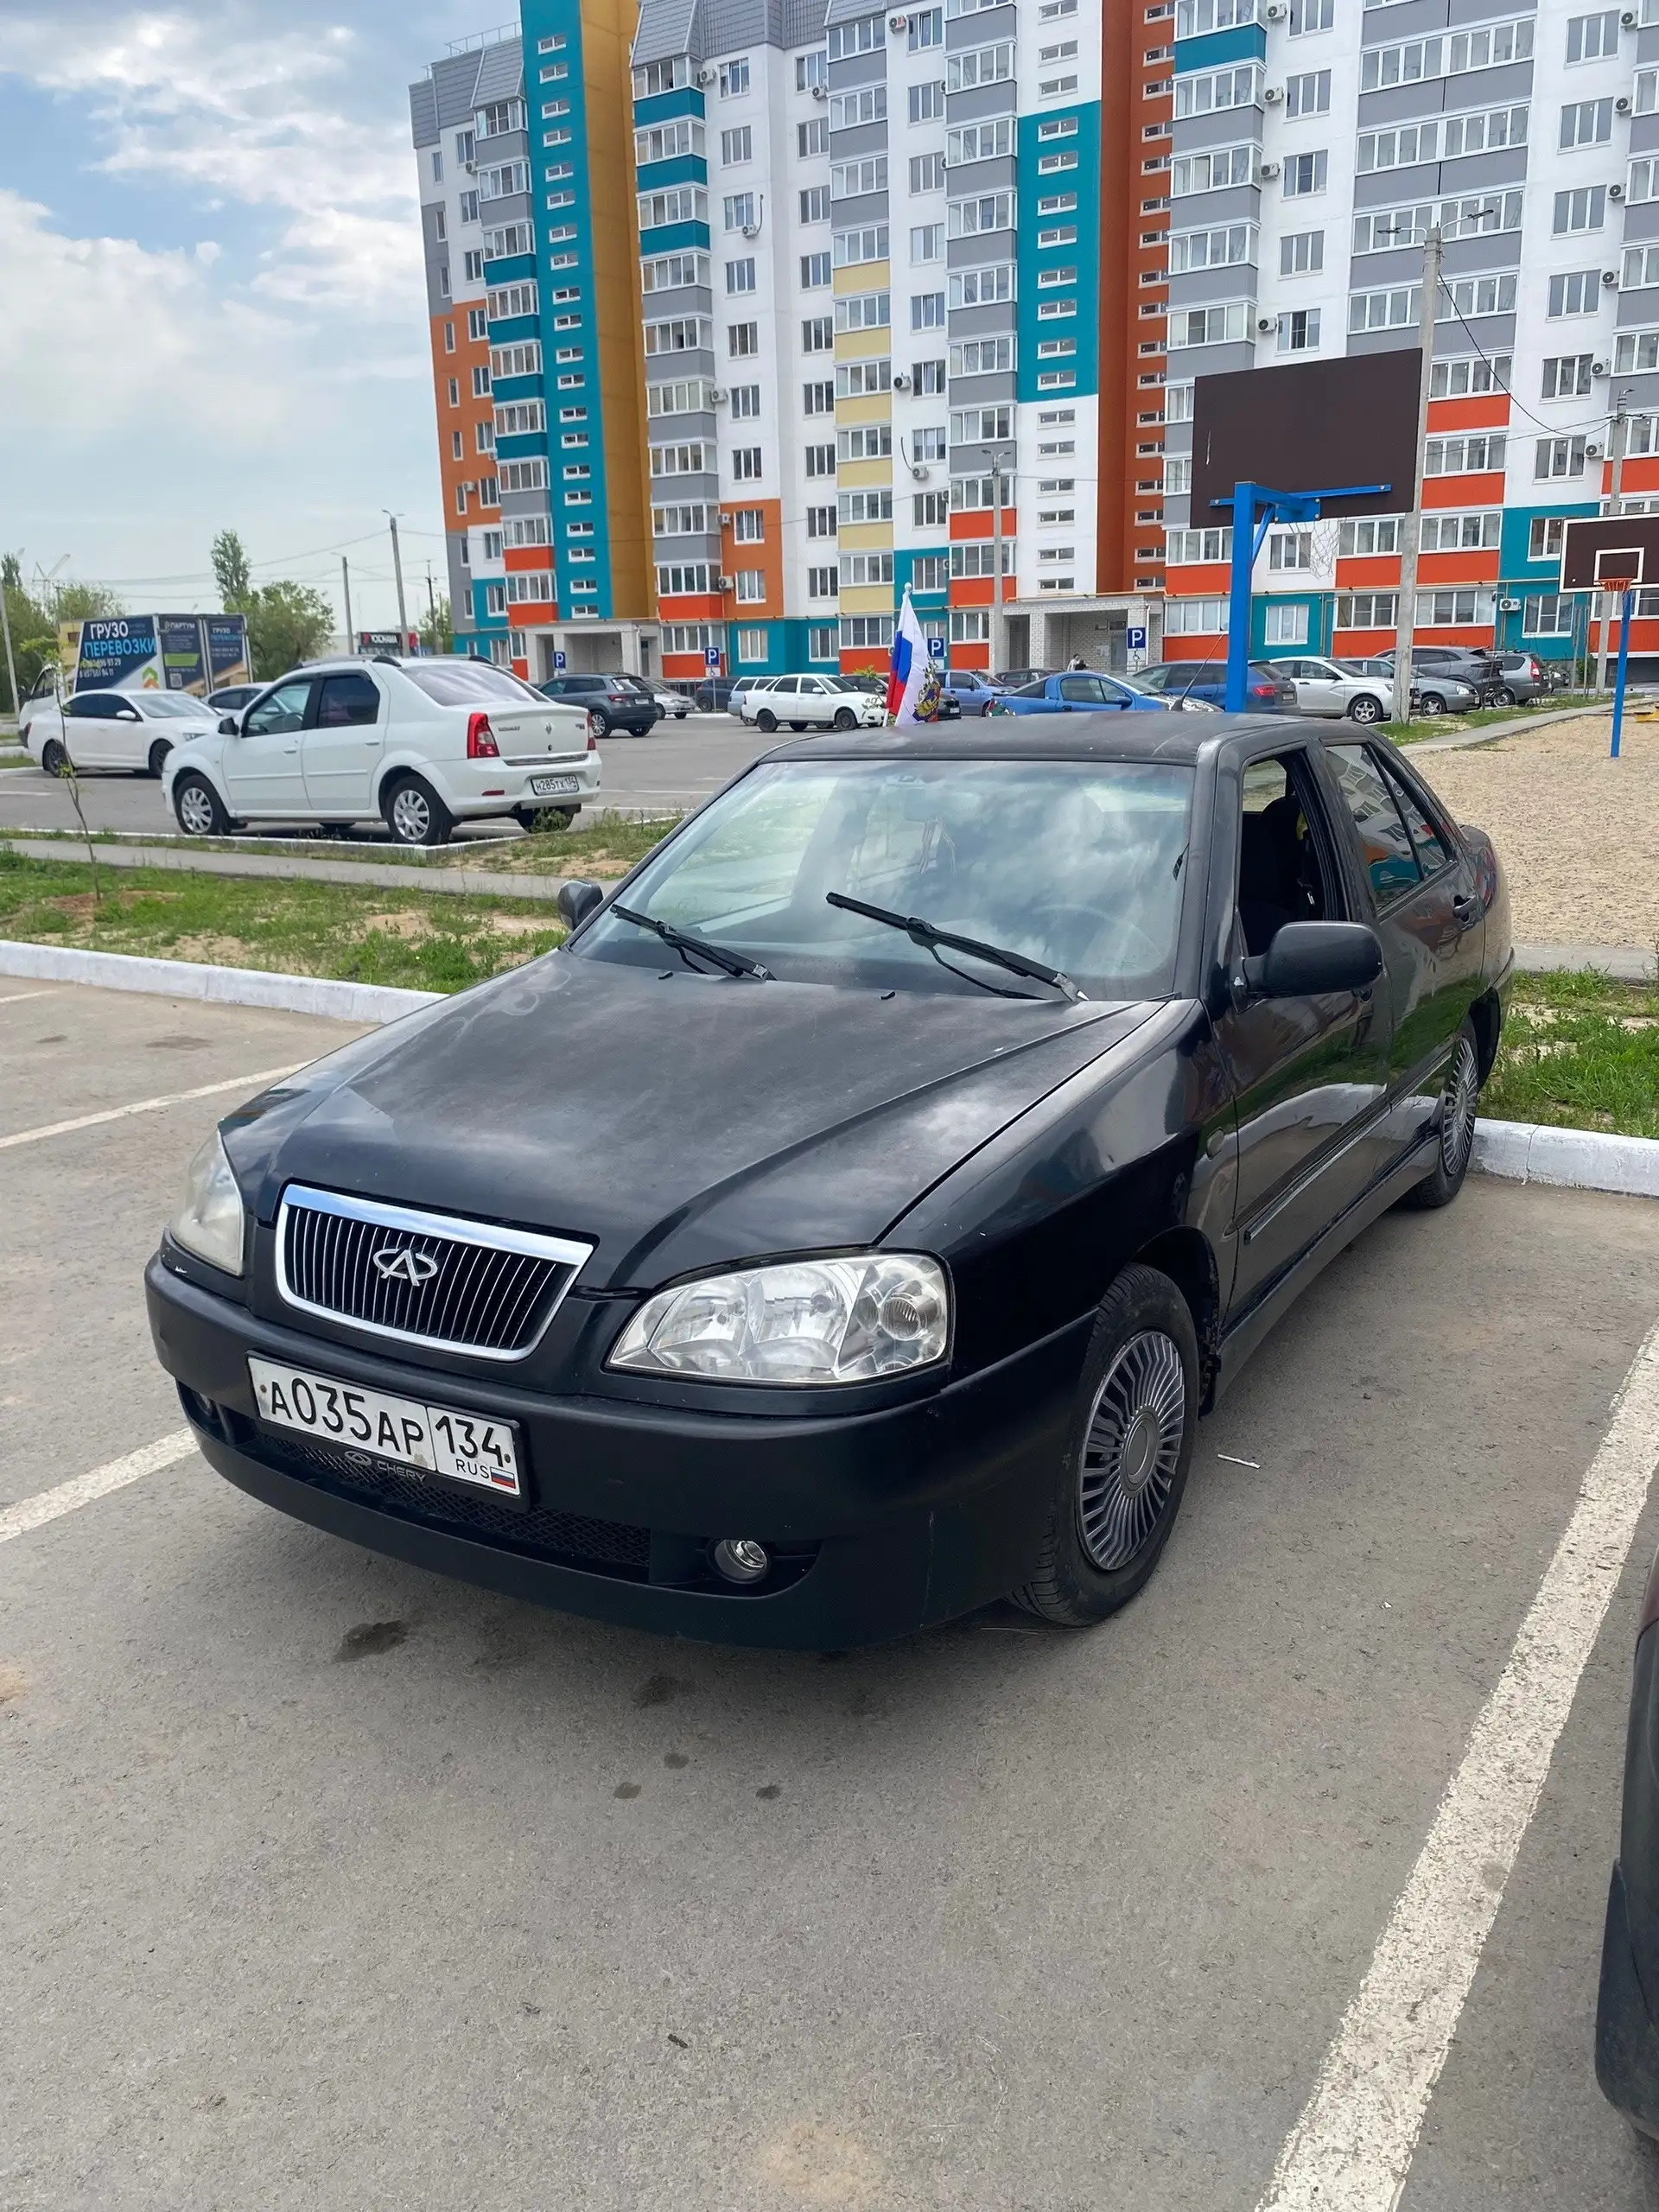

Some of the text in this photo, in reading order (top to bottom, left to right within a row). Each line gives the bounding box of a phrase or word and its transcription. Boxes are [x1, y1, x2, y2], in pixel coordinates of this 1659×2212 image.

[90, 621, 129, 639] ГРУЗО
[84, 638, 156, 658] ПЕРЕВОЗКИ
[271, 1377, 504, 1467] А035АР 134
[377, 1460, 428, 1483] CHERY
[456, 1458, 490, 1480] RUS
